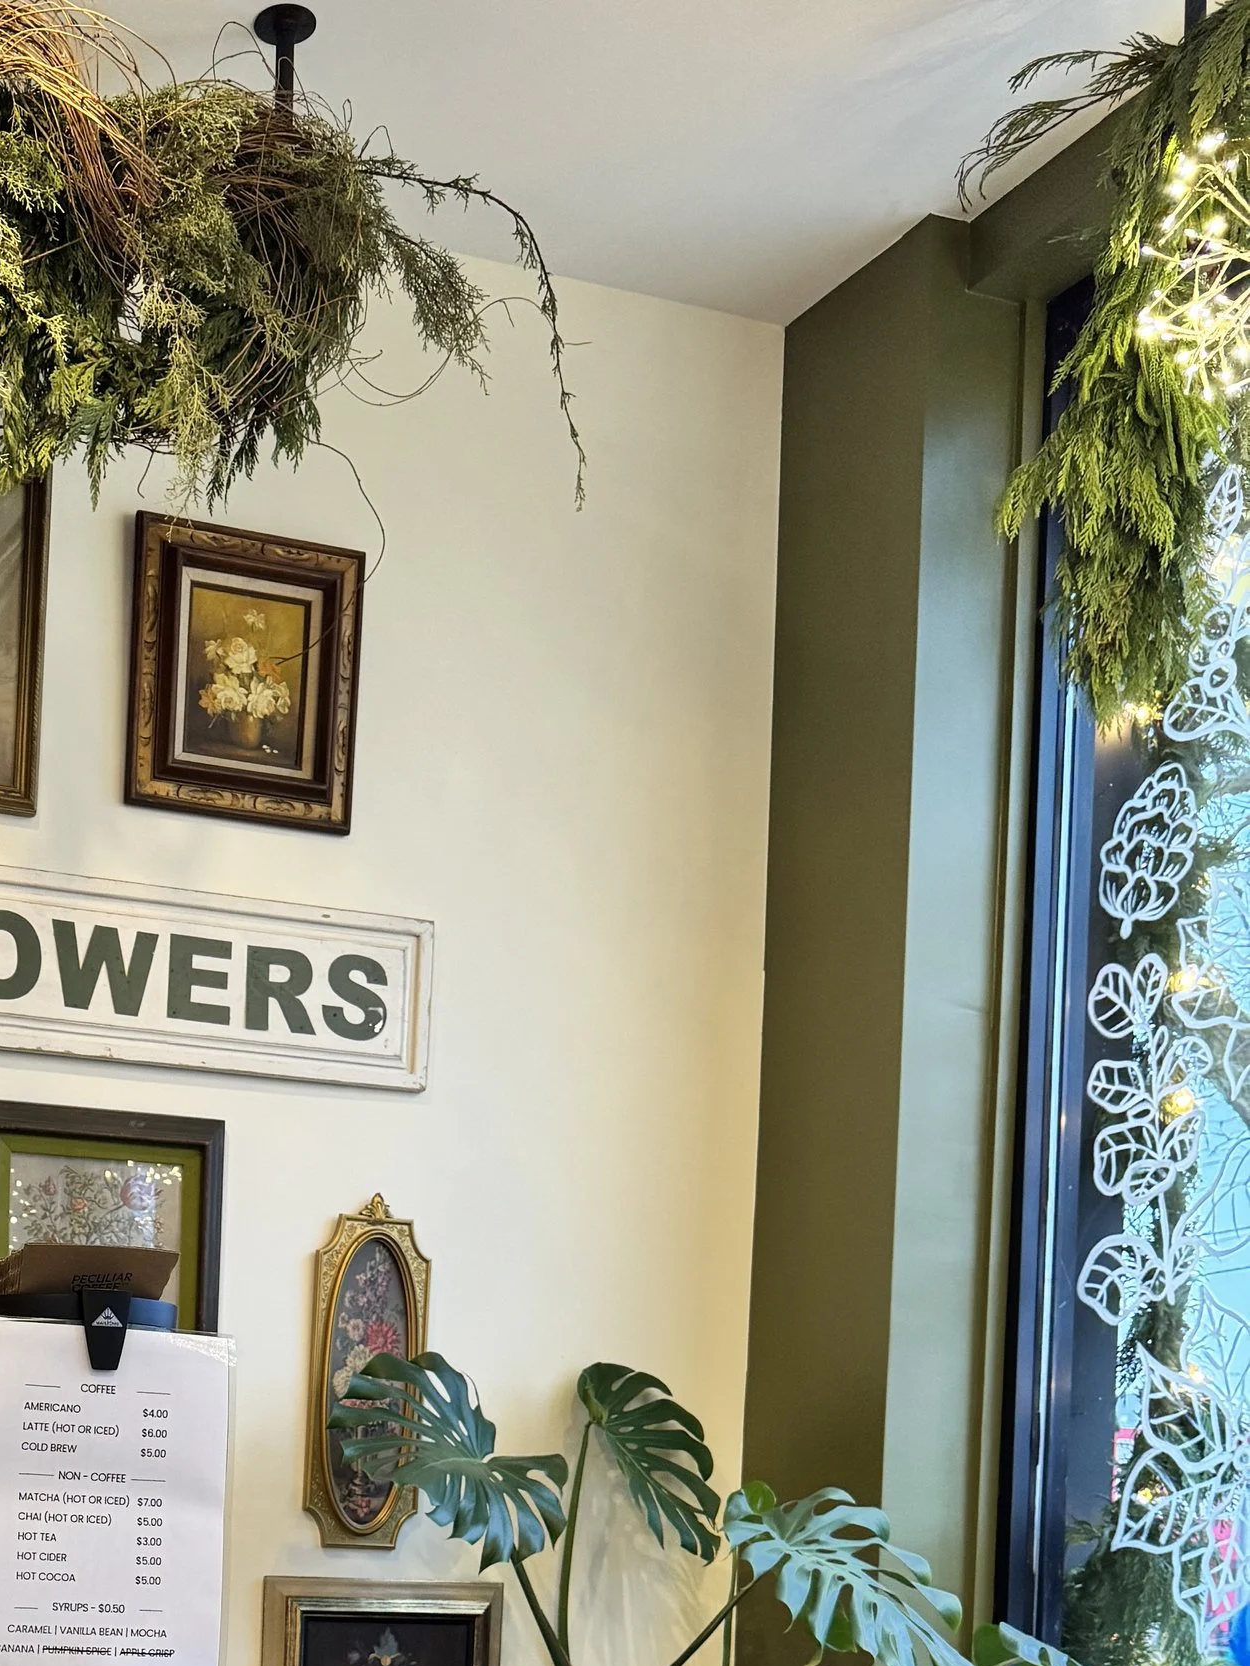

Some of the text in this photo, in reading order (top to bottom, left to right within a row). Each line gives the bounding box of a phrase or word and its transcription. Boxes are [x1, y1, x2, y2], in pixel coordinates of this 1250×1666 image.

[71, 1272, 133, 1285] PECULIAR
[81, 1384, 116, 1394] COFFEE
[24, 1402, 169, 1419] AMERICANO $4.00
[23, 1422, 168, 1438] LATTE (HOT OR ICED) $6.00
[22, 1442, 166, 1458] COLD BREW $5.00
[59, 1471, 81, 1481] NON
[91, 1472, 126, 1483] COFFEE
[18, 1492, 162, 1508] MATCHA (HOT OR ICED) $7.00
[18, 1511, 162, 1527] CHAI (HOT OR ICED) $5.00
[18, 1532, 162, 1547] HOT TEA $3.00
[17, 1552, 162, 1566] HOT CIDER $5.00
[16, 1572, 161, 1586] HOT COCOA $5.00
[52, 1602, 89, 1613] SYRUPS
[98, 1604, 125, 1614] $0.50
[8, 1625, 52, 1635] CARAMEL
[60, 1626, 97, 1636] VANILLA
[99, 1627, 124, 1636] BEAN
[130, 1629, 168, 1638] MOCHA
[42, 1646, 84, 1655] PUMPKIN
[86, 1647, 112, 1656] SPICE
[120, 1648, 146, 1657] APPLE
[150, 1649, 175, 1658] CRISP
